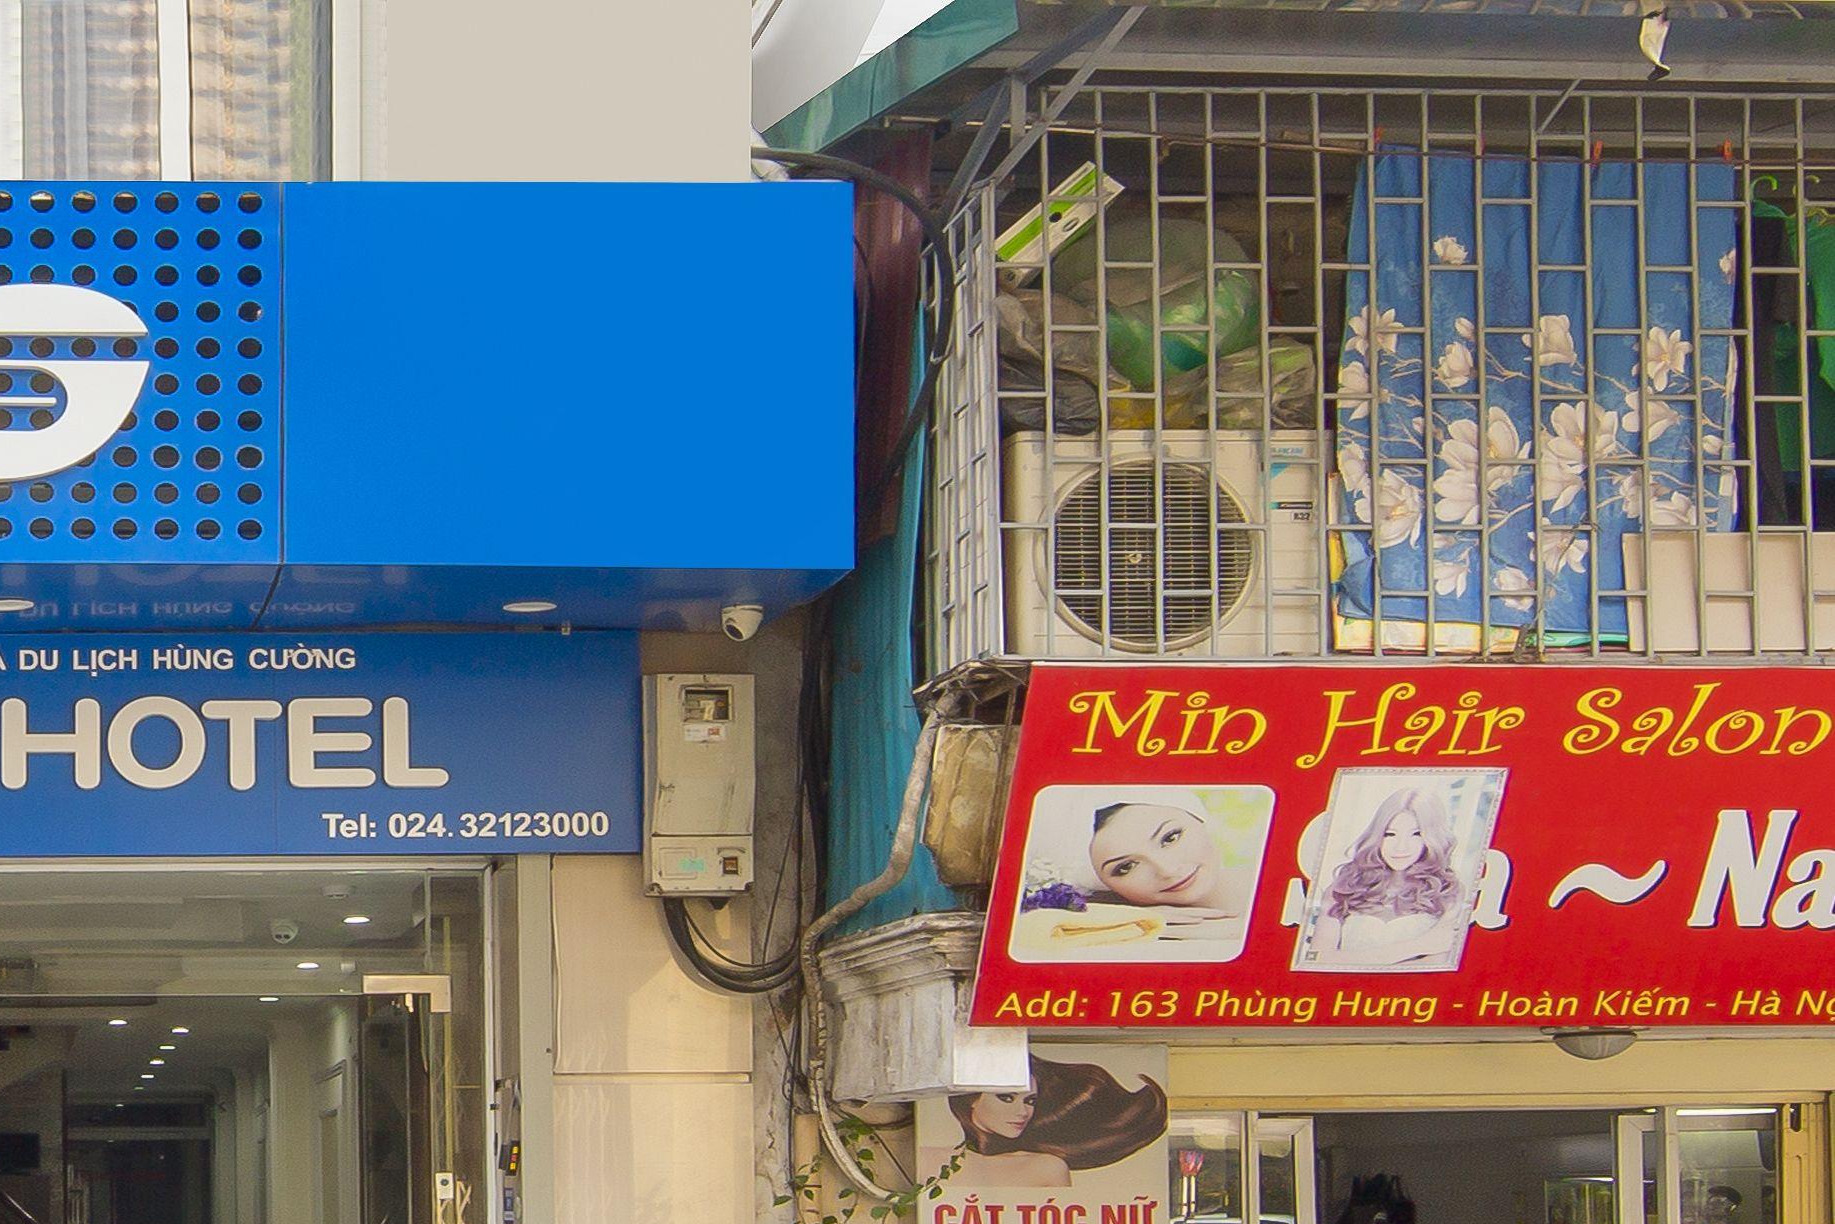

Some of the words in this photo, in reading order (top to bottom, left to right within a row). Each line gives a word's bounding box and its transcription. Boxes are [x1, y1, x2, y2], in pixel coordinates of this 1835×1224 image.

[19, 649, 59, 671] DU
[72, 648, 139, 678] LỊCH
[152, 643, 235, 671] HÙNG
[248, 642, 357, 671] CƯỜNG
[0, 695, 451, 792] HOTEL
[1068, 688, 1268, 757] Min
[1295, 682, 1527, 769] Hair
[1562, 682, 1833, 757] Salon
[321, 812, 378, 840] Tel:
[995, 990, 1088, 1019] Add:
[1110, 990, 1179, 1018] 163
[1195, 987, 1318, 1024] Phùng
[1332, 990, 1438, 1023] Hưng
[1478, 989, 1578, 1018] Hoàn
[1593, 985, 1691, 1017] Kiếm
[1731, 989, 1781, 1017] Hà
